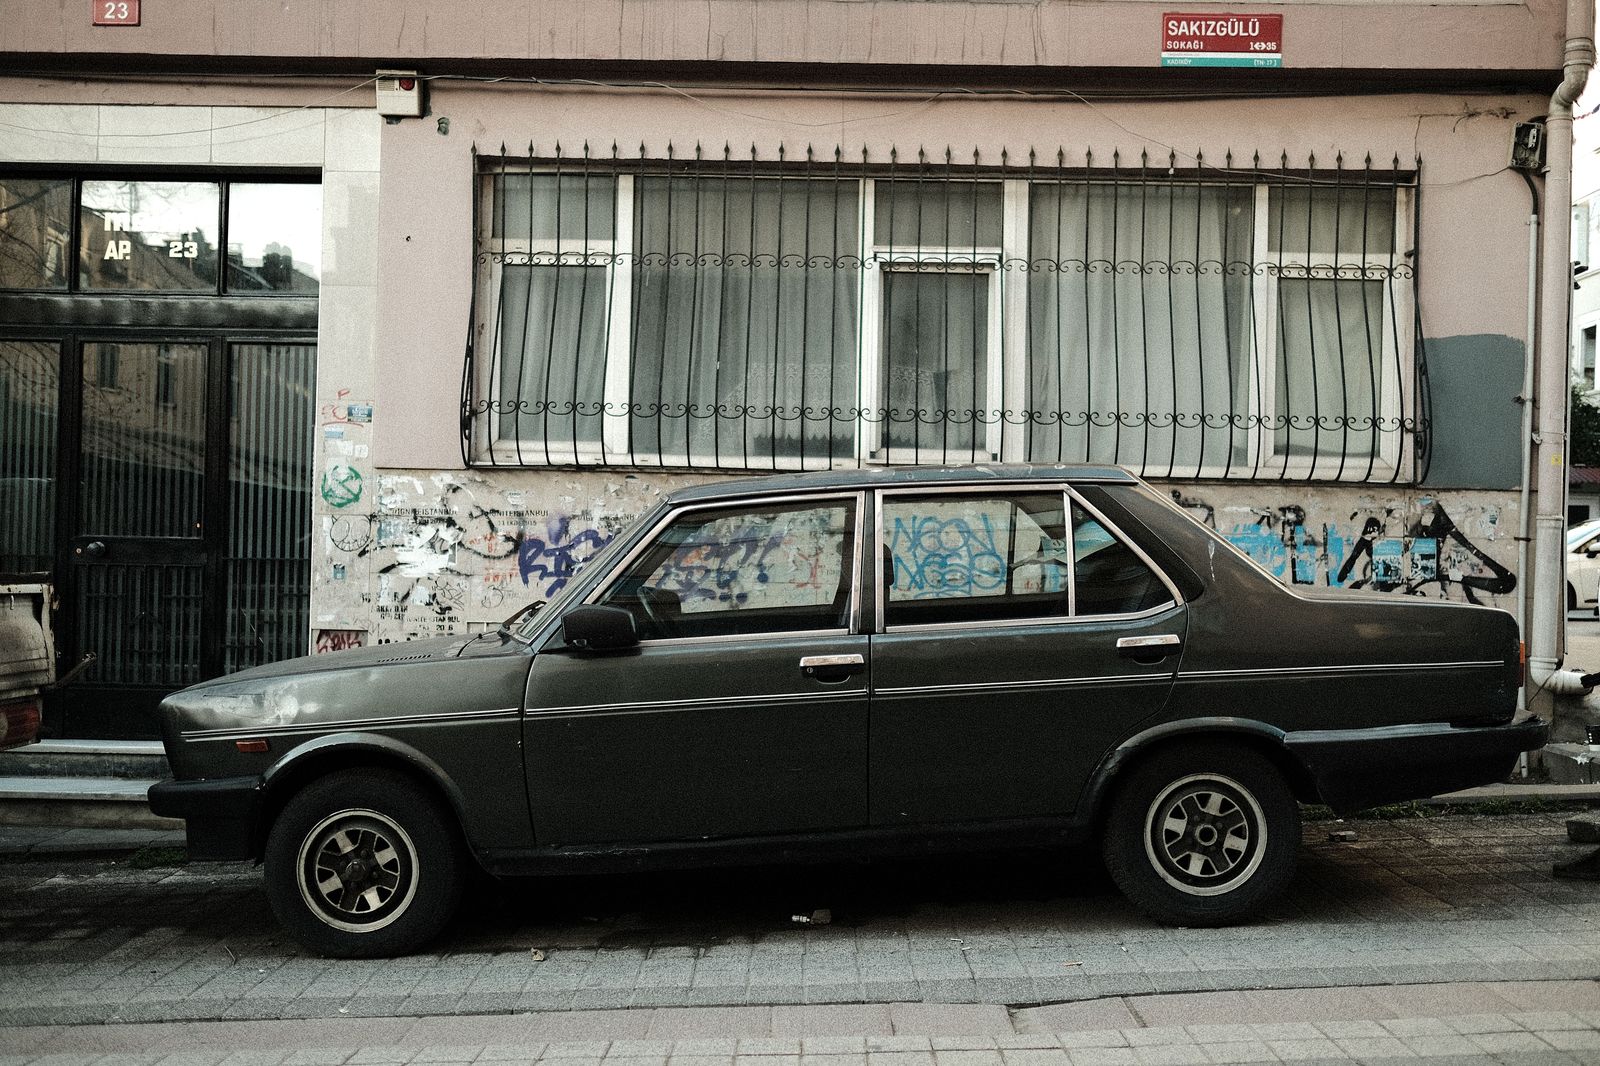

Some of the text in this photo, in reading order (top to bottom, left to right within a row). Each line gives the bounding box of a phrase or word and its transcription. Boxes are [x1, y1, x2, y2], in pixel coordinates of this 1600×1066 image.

[104, 2, 128, 19] 23
[1167, 18, 1260, 37] SAKIZGÜLÜ
[1166, 40, 1204, 50] SOKAĞI
[1266, 42, 1277, 51] 35
[103, 240, 198, 260] AP. 23
